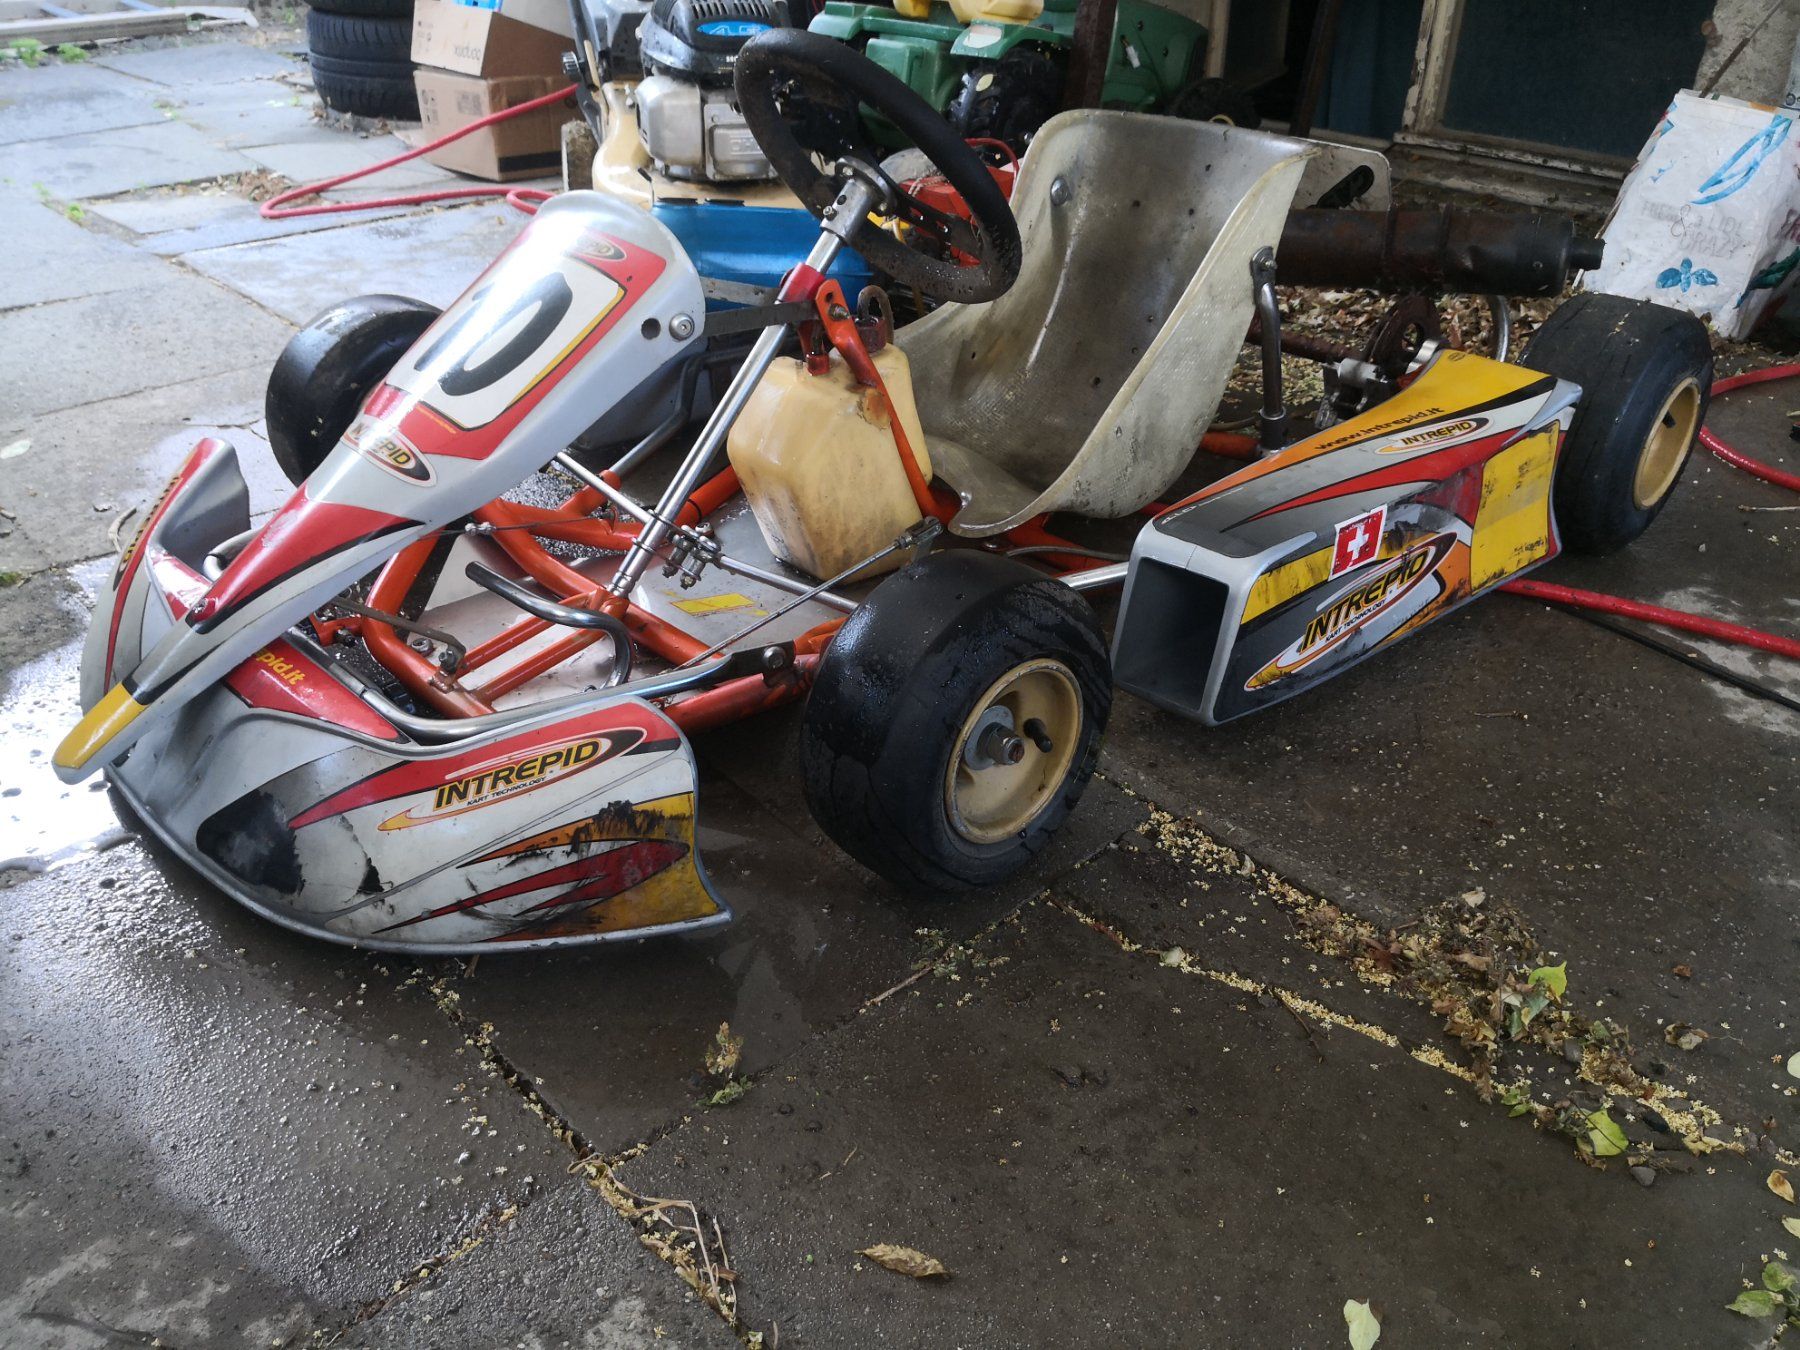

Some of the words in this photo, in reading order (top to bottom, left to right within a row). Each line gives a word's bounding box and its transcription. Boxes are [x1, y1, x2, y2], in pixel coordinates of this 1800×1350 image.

[1315, 406, 1446, 450] www.intrepid.it
[1401, 420, 1473, 446] INTREPID
[1299, 546, 1430, 655] INTREPID
[1325, 626, 1343, 642] KART
[1344, 598, 1387, 629] TECHNOLOGY
[433, 738, 602, 811] INTREPID
[467, 794, 489, 806] KART
[491, 776, 547, 798] TECHNOLOGY
